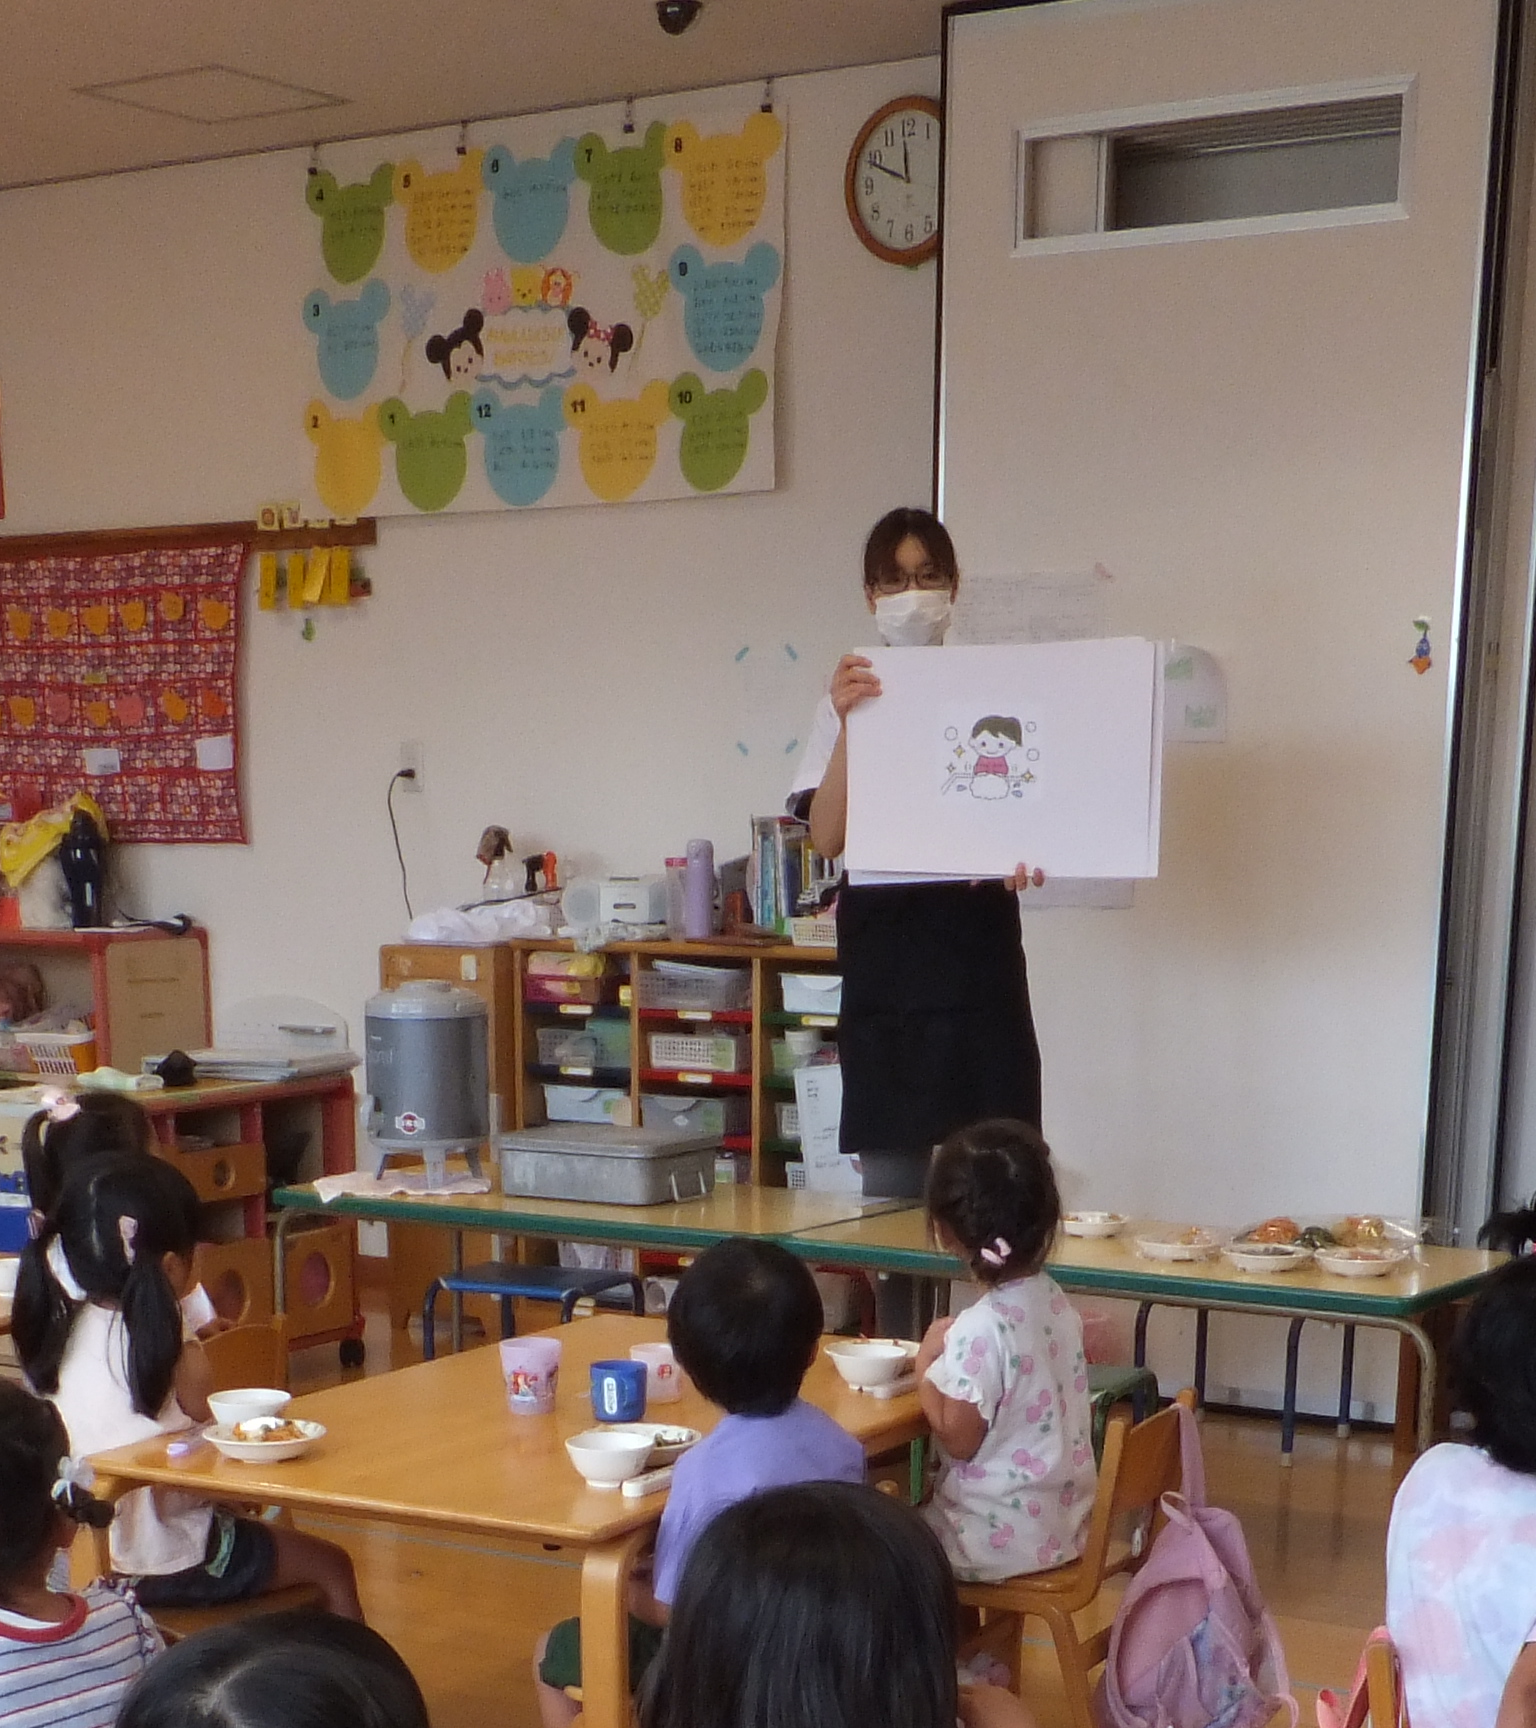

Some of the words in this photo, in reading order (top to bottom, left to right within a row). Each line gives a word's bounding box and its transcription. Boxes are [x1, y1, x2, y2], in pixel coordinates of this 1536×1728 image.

[901, 118, 916, 138] 12
[674, 137, 683, 153] 8
[884, 129, 895, 147] 11
[585, 148, 593, 163] 7
[490, 158, 500, 174] 6
[402, 173, 412, 189] 5
[863, 177, 874, 197] 9
[315, 188, 324, 201] 4
[871, 202, 880, 222] 8
[886, 219, 894, 238] 7
[904, 223, 914, 242] 6
[923, 215, 933, 234] 5
[312, 303, 320, 317] 3
[676, 390, 693, 404] 10
[476, 403, 492, 419] 12
[571, 399, 586, 414] 11
[311, 415, 319, 429] 2
